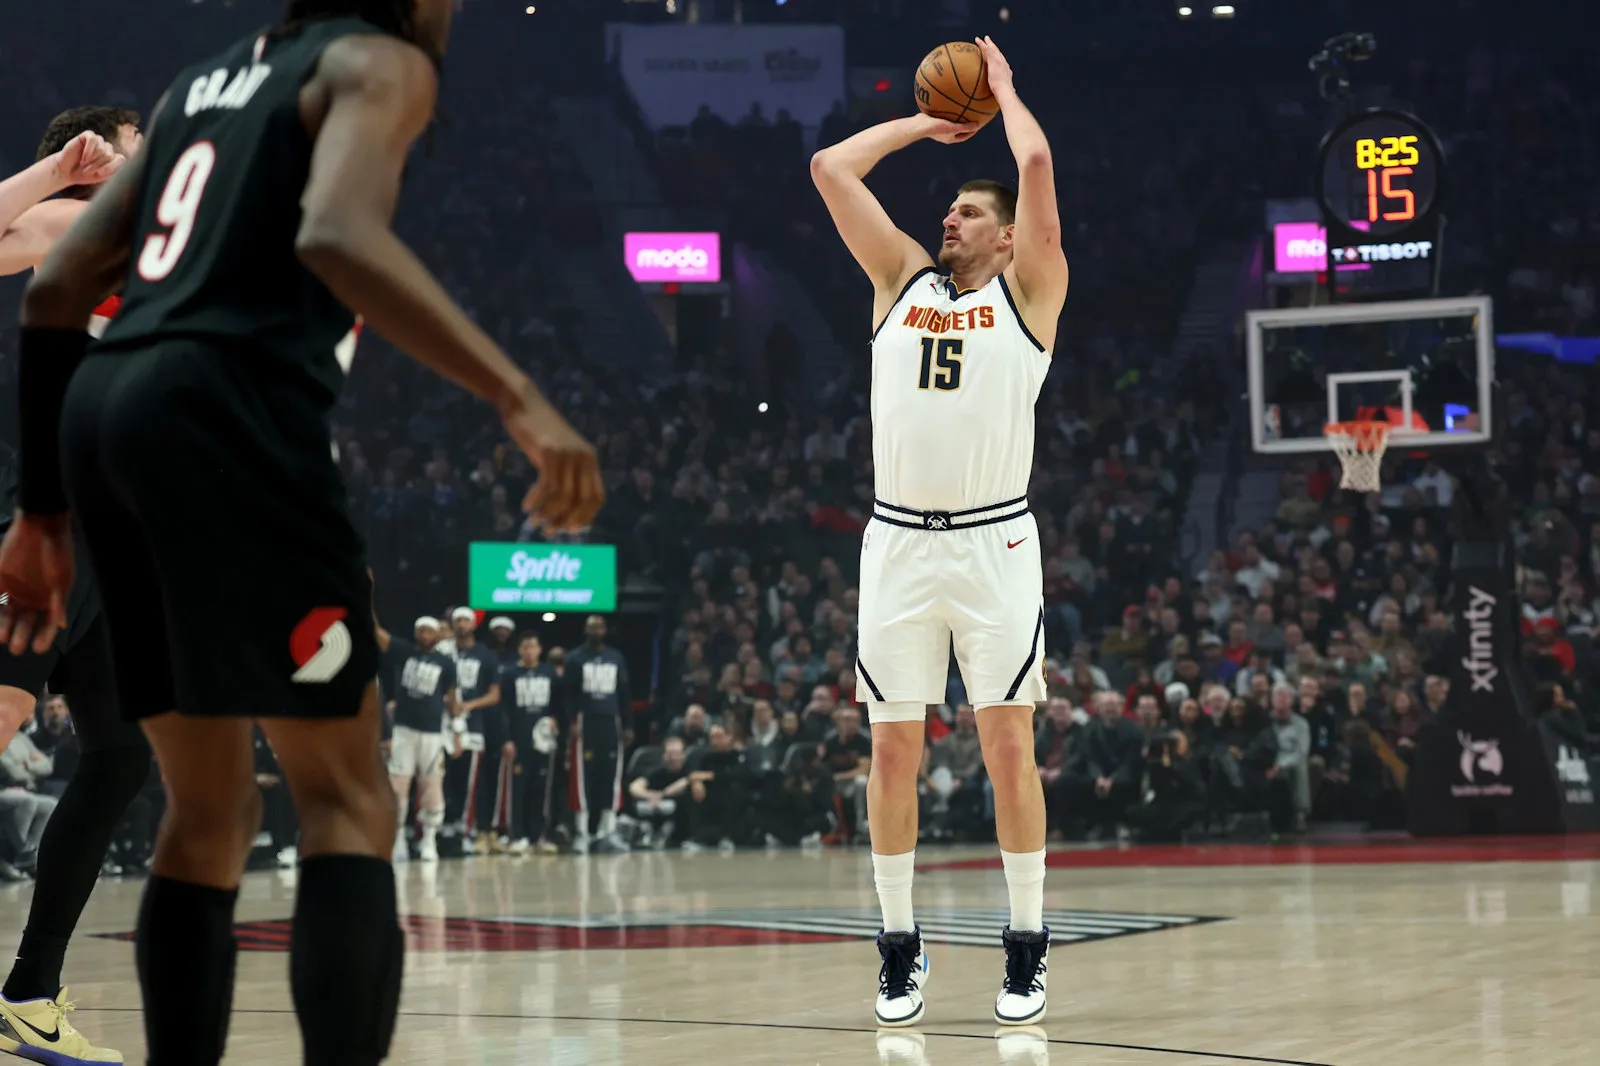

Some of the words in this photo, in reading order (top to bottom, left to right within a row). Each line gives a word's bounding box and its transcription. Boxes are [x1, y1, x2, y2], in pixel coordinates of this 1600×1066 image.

[1356, 135, 1419, 169] 8:25
[137, 139, 216, 281] 9
[1367, 166, 1415, 223] 15
[636, 243, 709, 269] moda
[1286, 239, 1327, 258] mo
[1357, 241, 1432, 262] TISSOT
[902, 305, 995, 334] NUGGETS
[918, 336, 964, 392] 15
[506, 550, 581, 587] Sprite
[1461, 586, 1498, 692] xfinity
